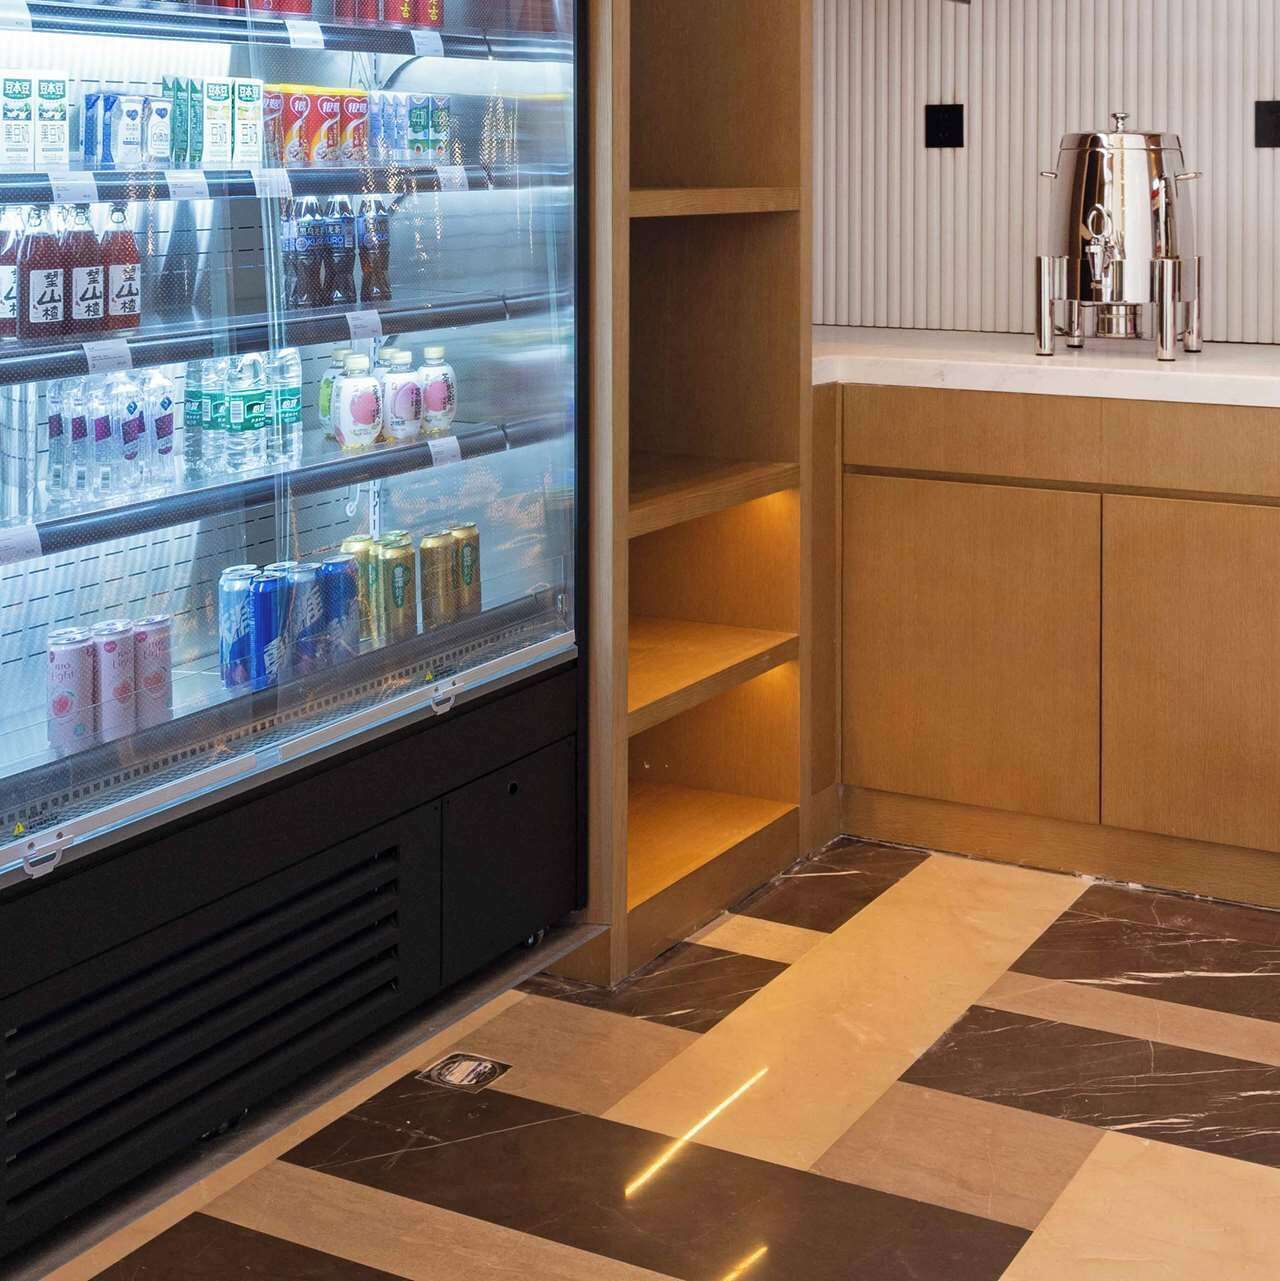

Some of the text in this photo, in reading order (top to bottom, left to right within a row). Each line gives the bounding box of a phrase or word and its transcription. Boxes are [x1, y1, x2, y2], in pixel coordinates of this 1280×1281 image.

[36, 270, 62, 321] 望山楂
[79, 267, 103, 318] 望山楂
